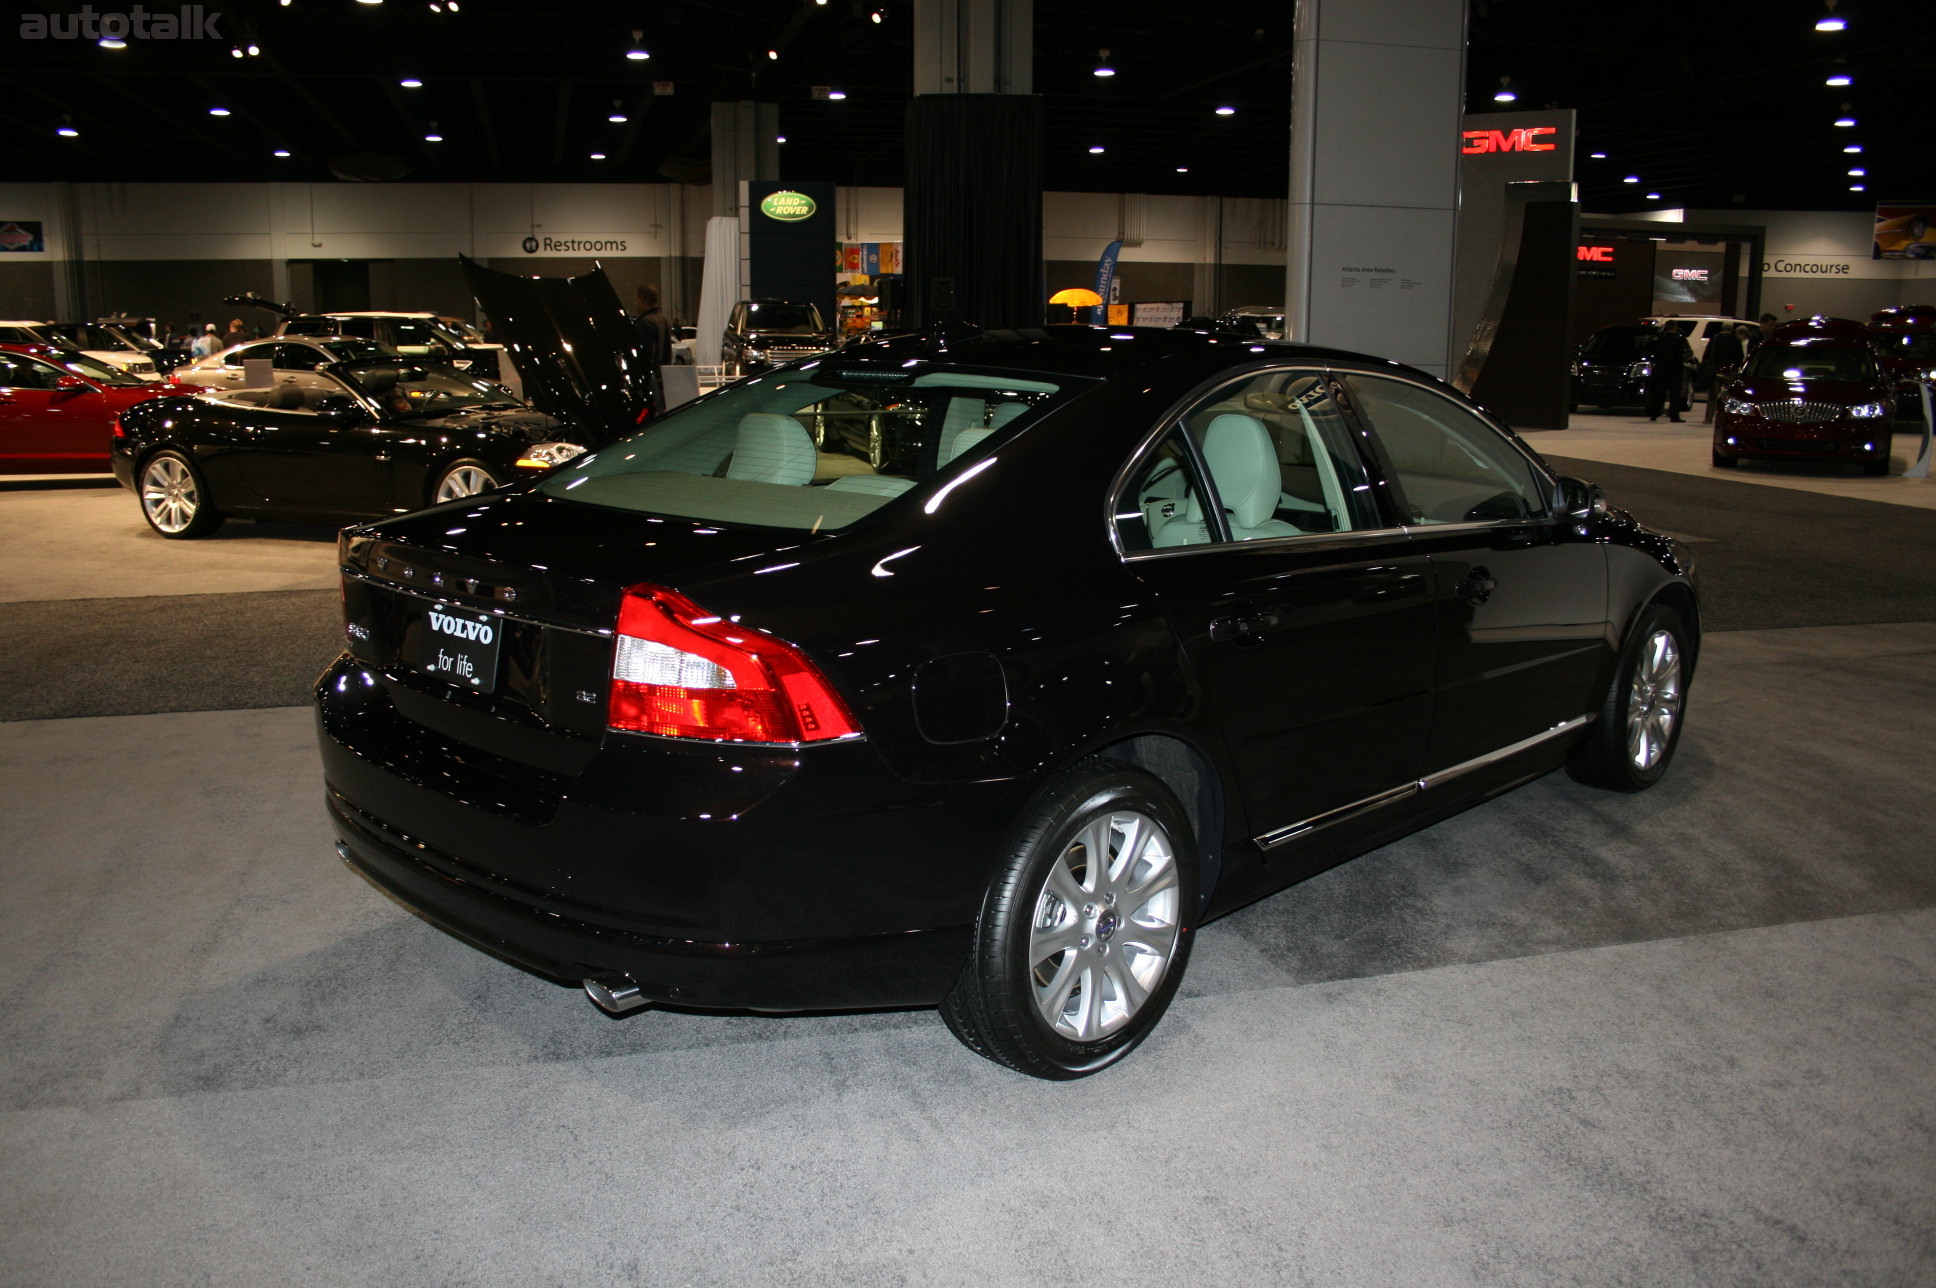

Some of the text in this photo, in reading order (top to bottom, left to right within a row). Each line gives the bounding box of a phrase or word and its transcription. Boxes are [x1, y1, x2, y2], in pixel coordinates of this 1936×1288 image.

[1462, 127, 1556, 154] GMC
[773, 197, 801, 206] LAND
[775, 206, 809, 215] ROVER
[543, 237, 627, 252] Restrooms
[1577, 246, 1614, 261] MC
[1774, 259, 1850, 274] Concourse
[1672, 268, 1709, 281] GMC
[428, 611, 493, 645] VOLVO
[438, 648, 474, 678] for life
